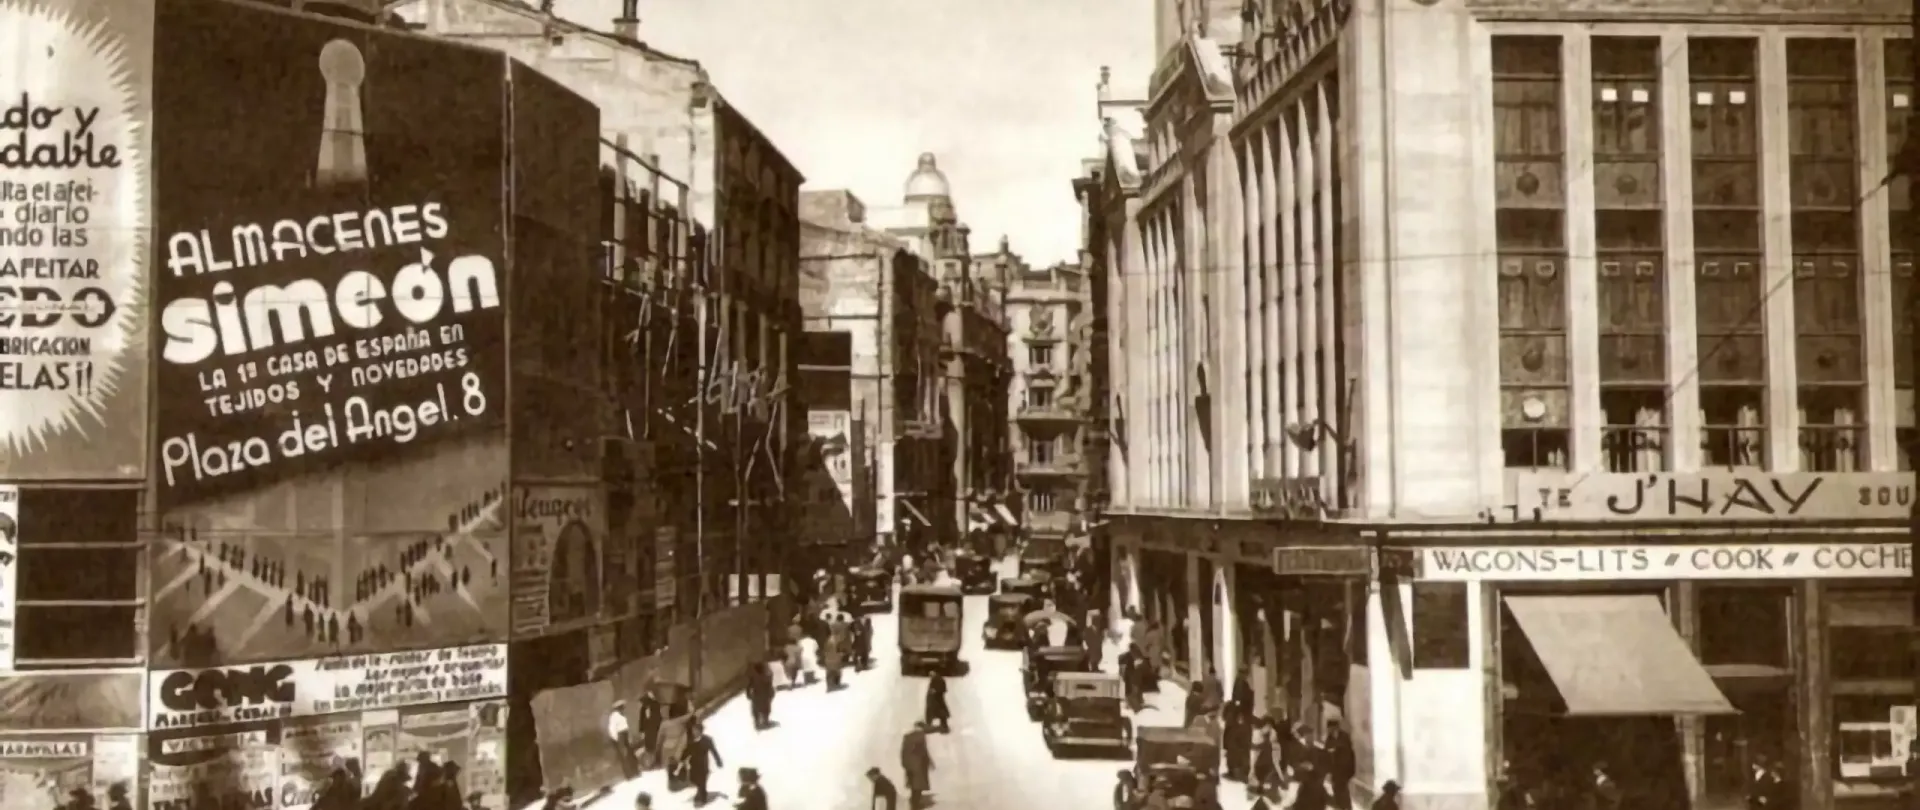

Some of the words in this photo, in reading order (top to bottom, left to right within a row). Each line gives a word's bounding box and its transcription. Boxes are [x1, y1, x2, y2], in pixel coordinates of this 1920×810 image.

[74, 106, 100, 140] y
[14, 201, 90, 224] diario
[52, 223, 88, 247] las
[168, 203, 449, 277] ALMACENES
[0, 257, 100, 279] AFEITAR
[198, 368, 227, 391] LA
[266, 350, 319, 377] CASA
[324, 343, 349, 368] DE
[355, 325, 431, 359] ESPAÑA
[204, 381, 300, 418] TEJIDOS
[316, 374, 333, 394] Y
[351, 348, 469, 387] NOVEDADES
[162, 432, 271, 488] Plaza
[278, 402, 339, 457] del
[461, 372, 487, 416] 8
[1432, 549, 1649, 573] WAGONS-LITS
[1690, 547, 1774, 570] COOK
